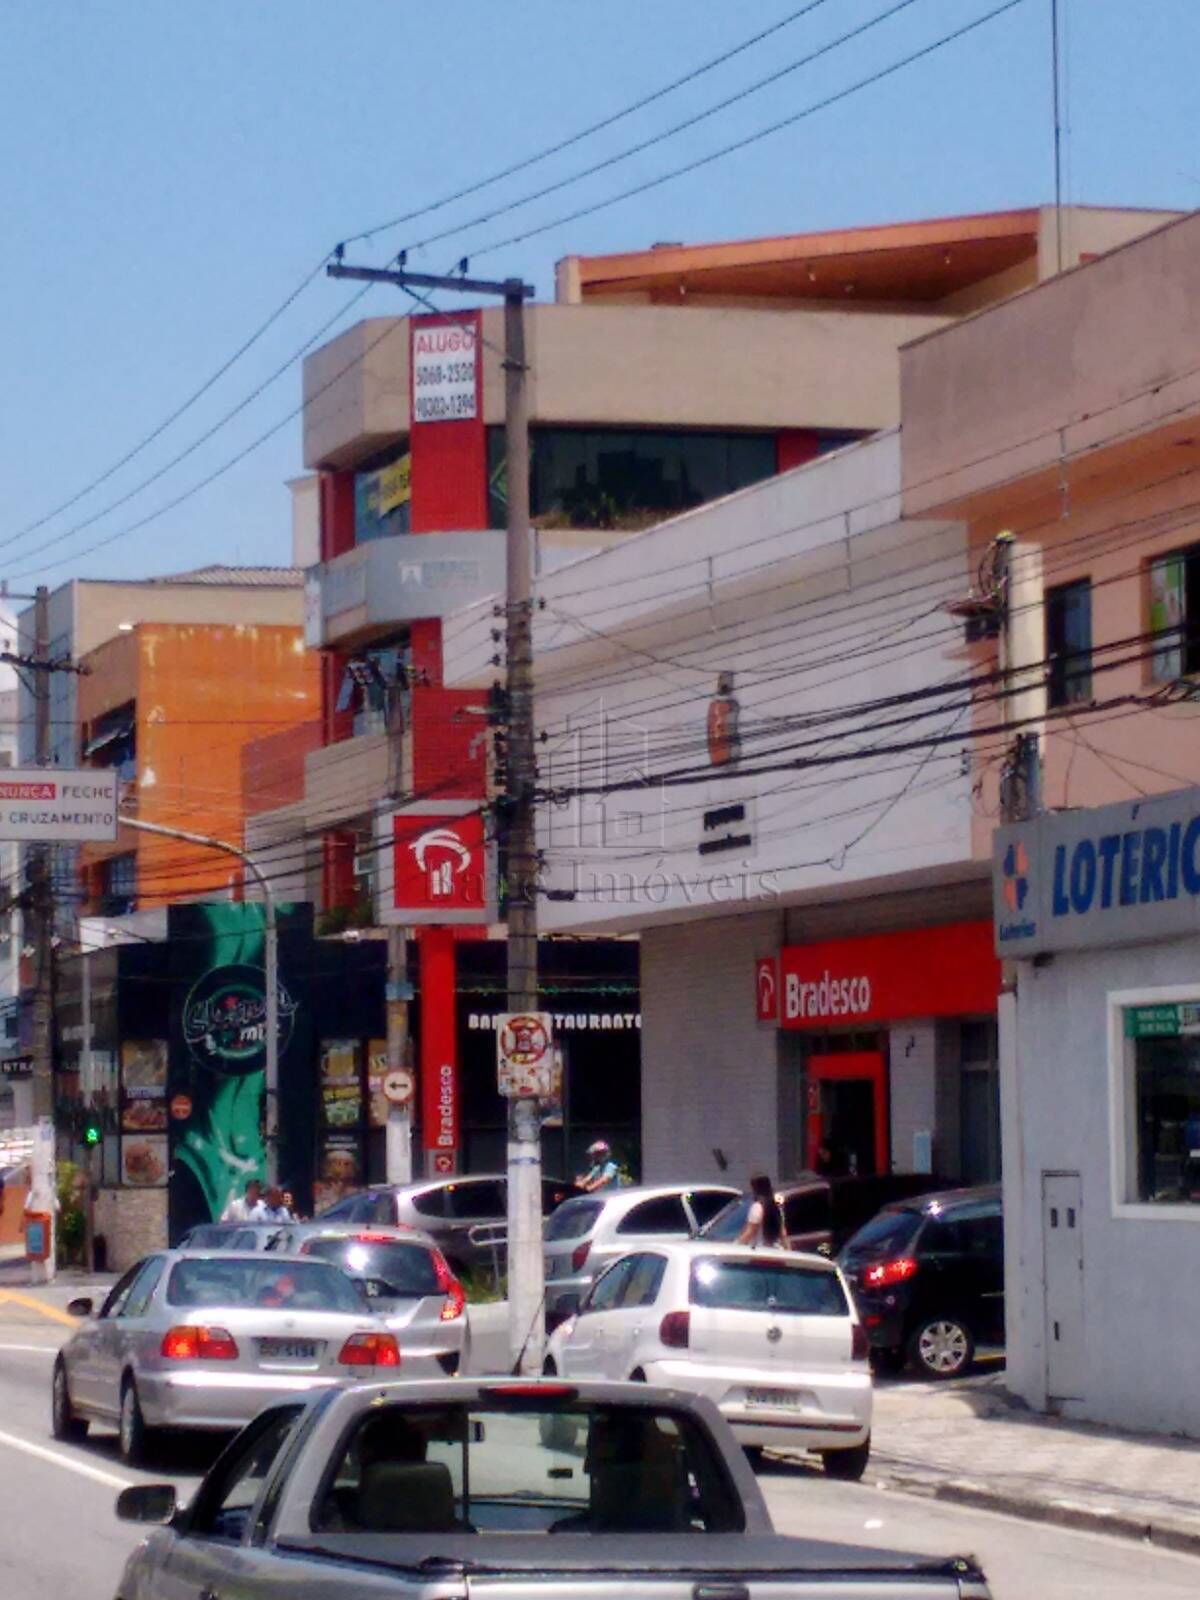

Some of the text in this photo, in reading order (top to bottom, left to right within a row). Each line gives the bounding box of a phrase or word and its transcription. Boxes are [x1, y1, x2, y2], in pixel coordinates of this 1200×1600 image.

[416, 331, 475, 354] ALUGO
[62, 785, 113, 799] FECHE
[9, 811, 114, 825] CRUZAMENTO
[785, 970, 871, 1019] Bradesco
[438, 1064, 454, 1147] Bradesco
